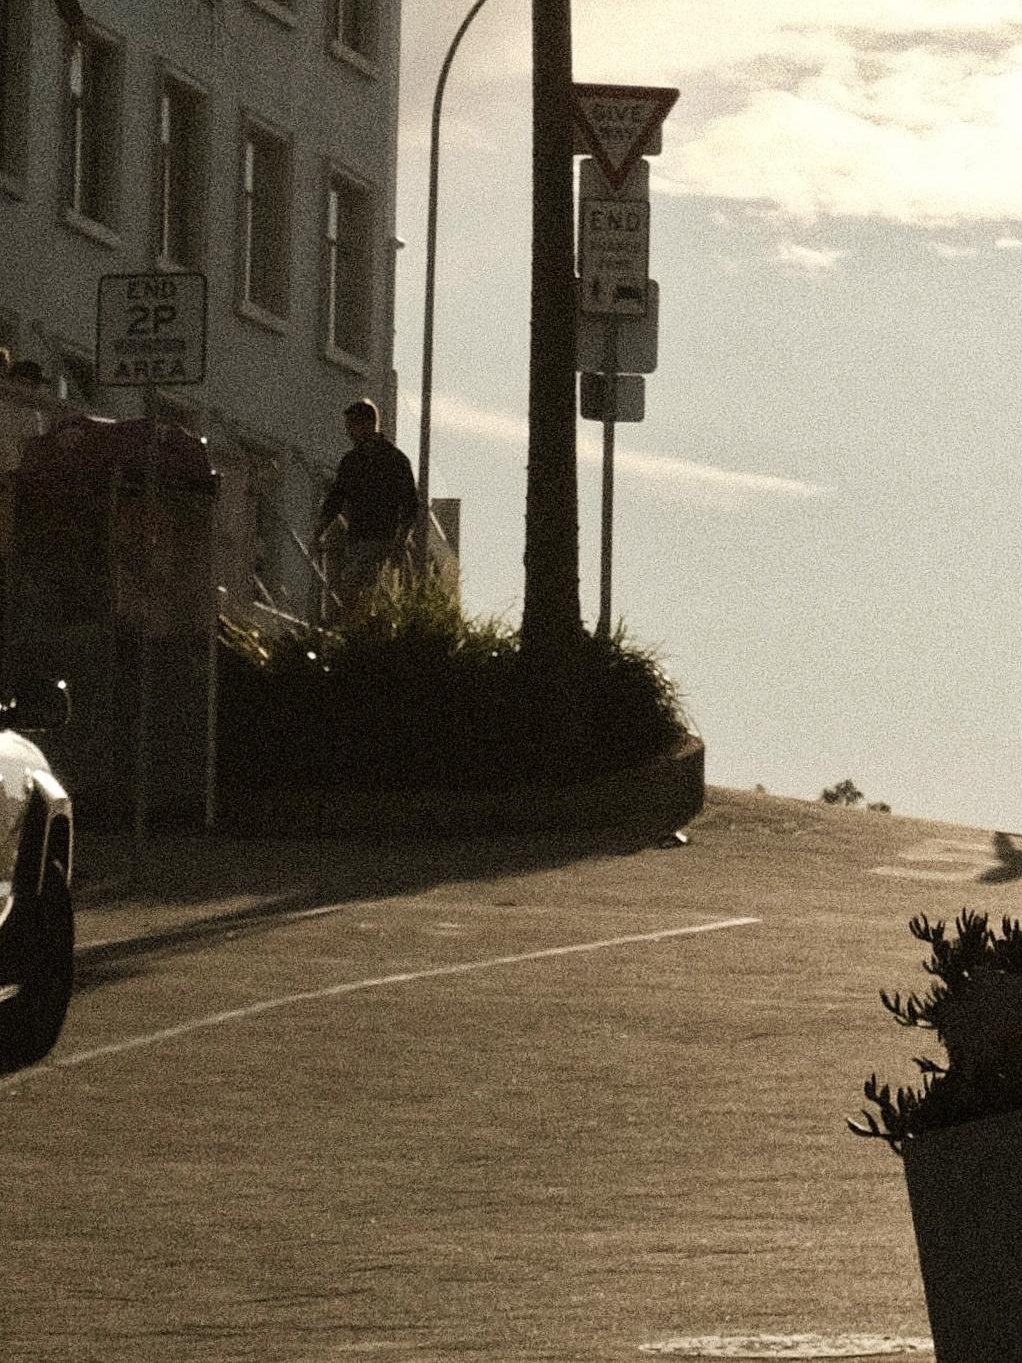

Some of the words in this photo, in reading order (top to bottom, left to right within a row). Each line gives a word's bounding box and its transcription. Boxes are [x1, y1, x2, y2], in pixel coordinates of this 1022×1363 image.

[592, 103, 645, 123] GIVE
[590, 209, 641, 232] END
[127, 280, 177, 299] END
[125, 305, 177, 335] 2P
[114, 358, 187, 379] AREA
